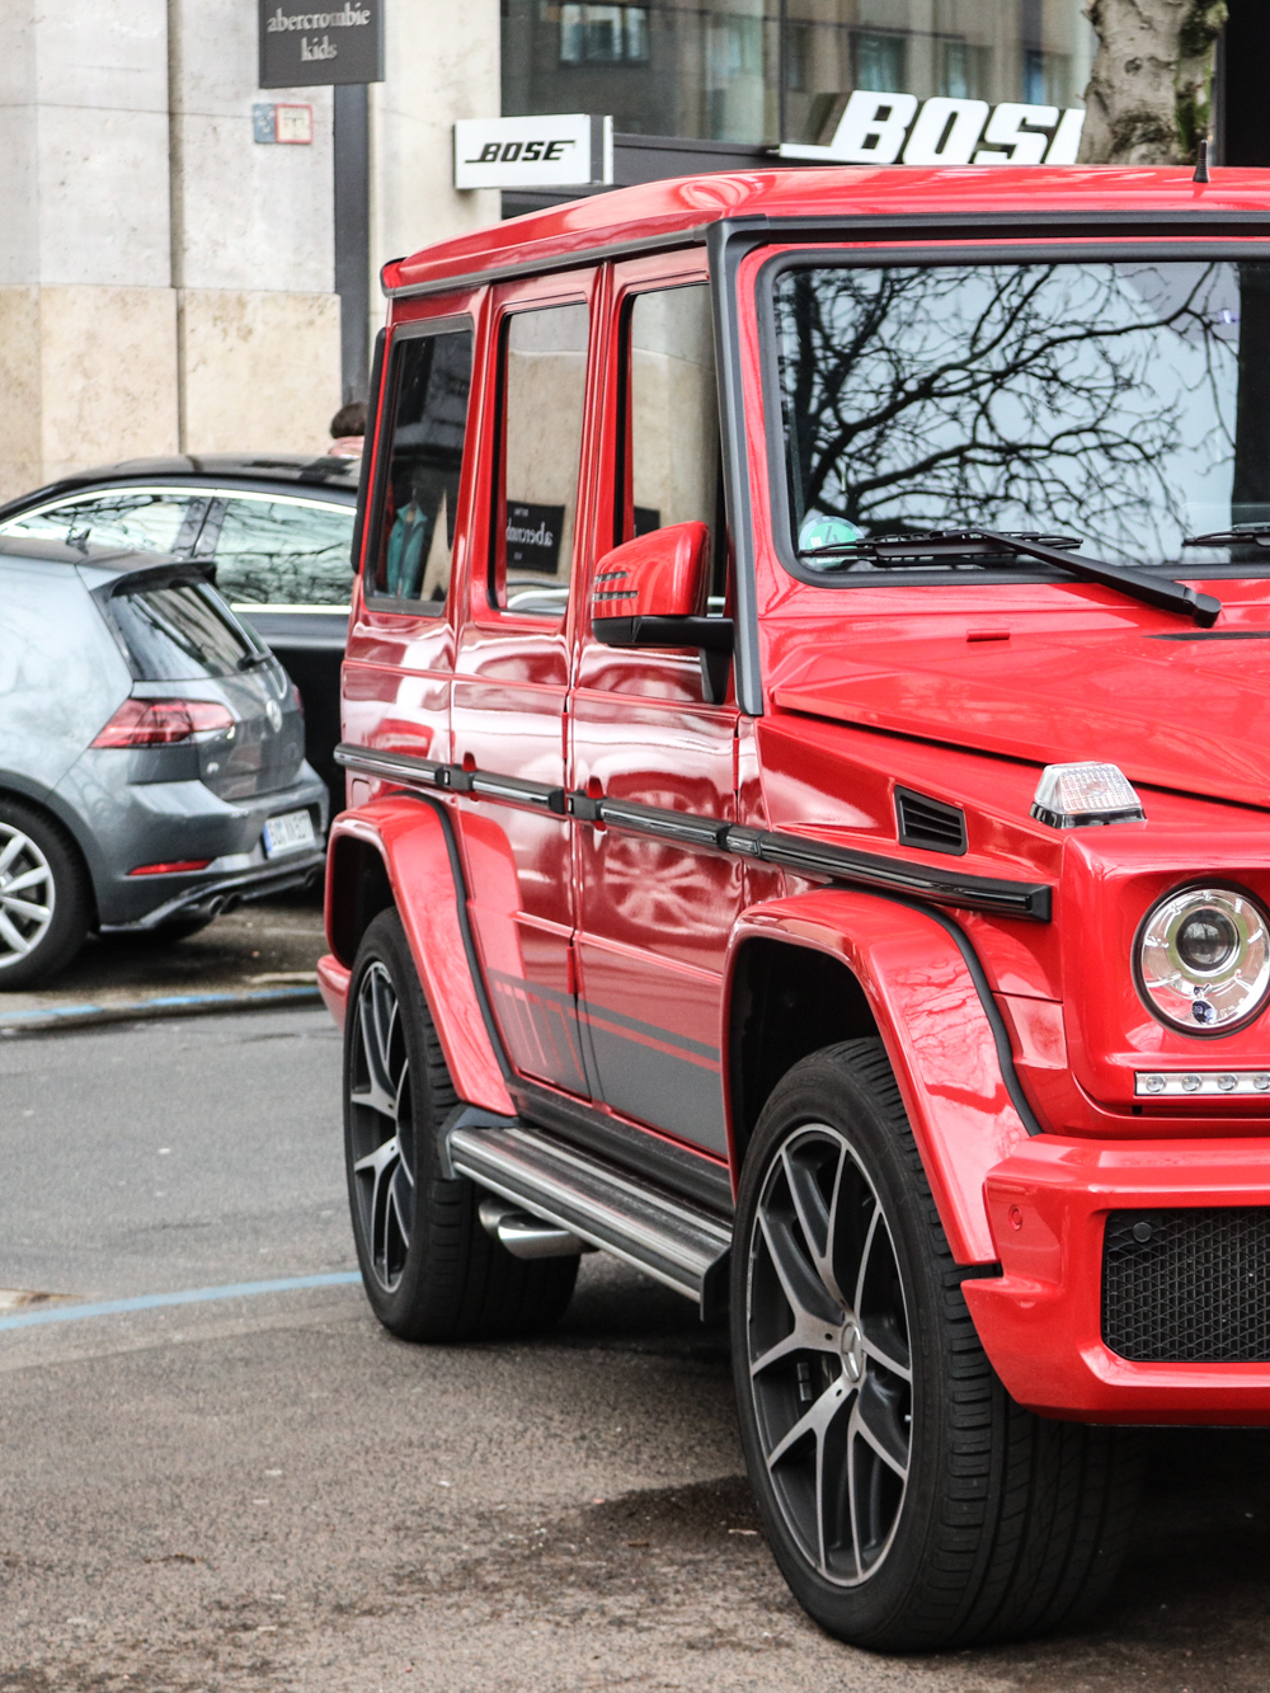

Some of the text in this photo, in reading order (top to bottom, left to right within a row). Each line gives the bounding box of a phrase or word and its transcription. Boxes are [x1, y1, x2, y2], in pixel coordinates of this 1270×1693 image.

[267, 2, 371, 33] abercrombie
[300, 35, 338, 61] kids
[465, 140, 576, 164] BOSE
